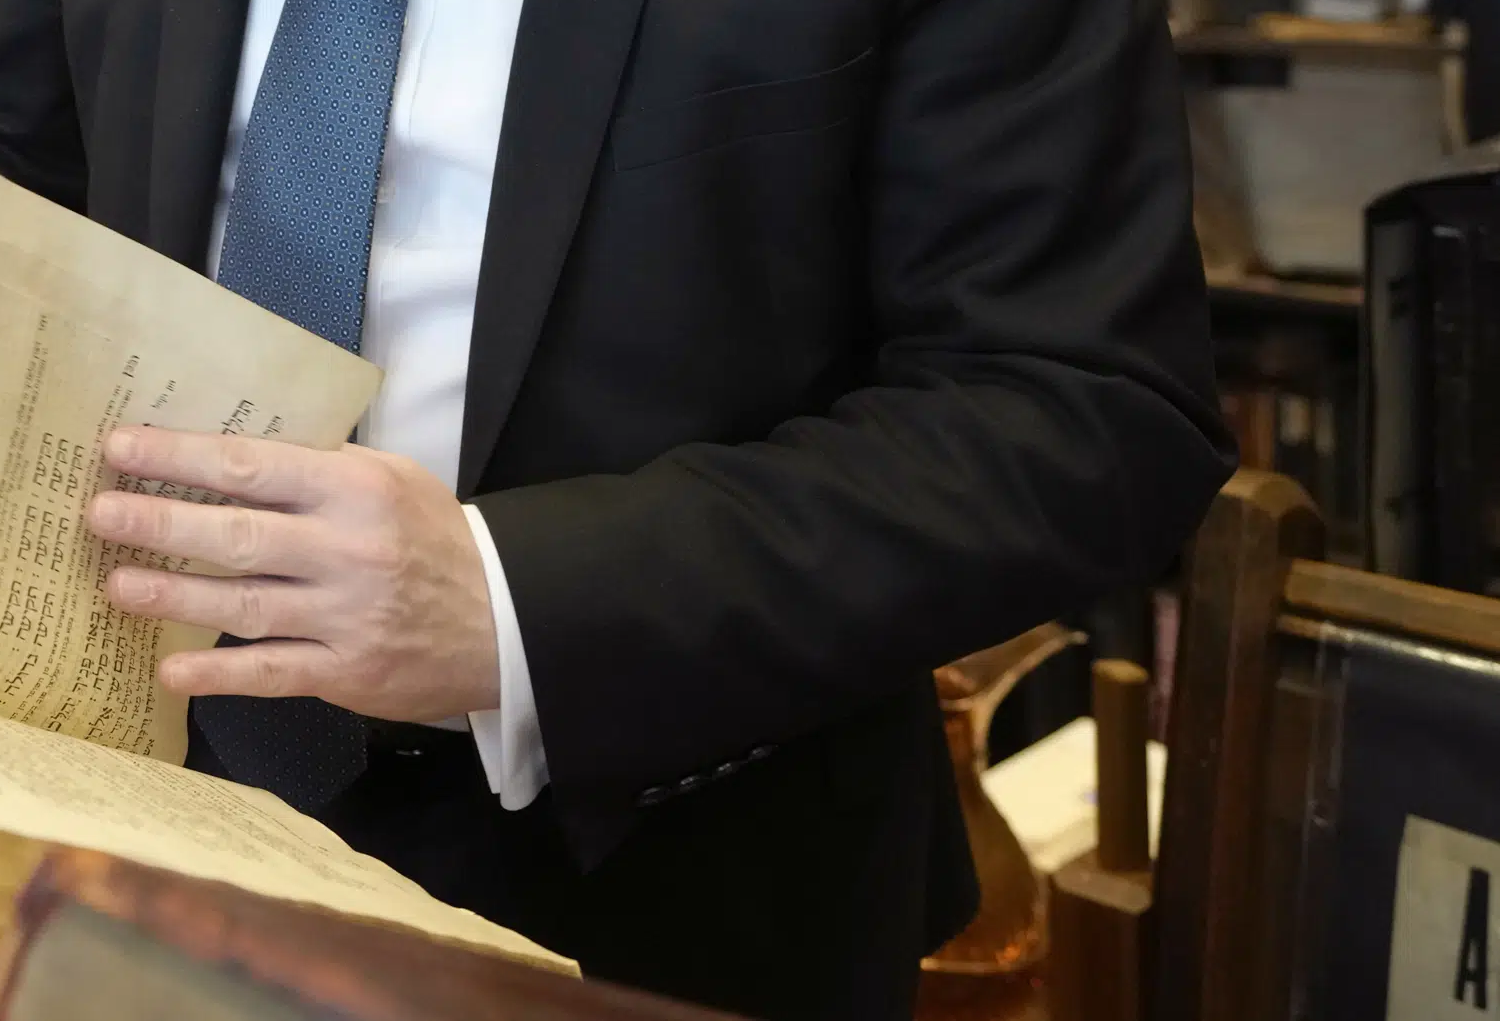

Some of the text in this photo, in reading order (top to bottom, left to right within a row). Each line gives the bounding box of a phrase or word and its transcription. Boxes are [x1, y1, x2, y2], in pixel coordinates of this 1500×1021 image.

[32, 432, 54, 487] תקיעה
[64, 444, 85, 499] תקיעה
[15, 438, 69, 641] תקיעה תרועה תקיעה
[16, 504, 38, 561] תרועה
[49, 516, 70, 573] תרועה
[32, 592, 56, 647] תקיעה
[3, 653, 39, 697] גדולה
